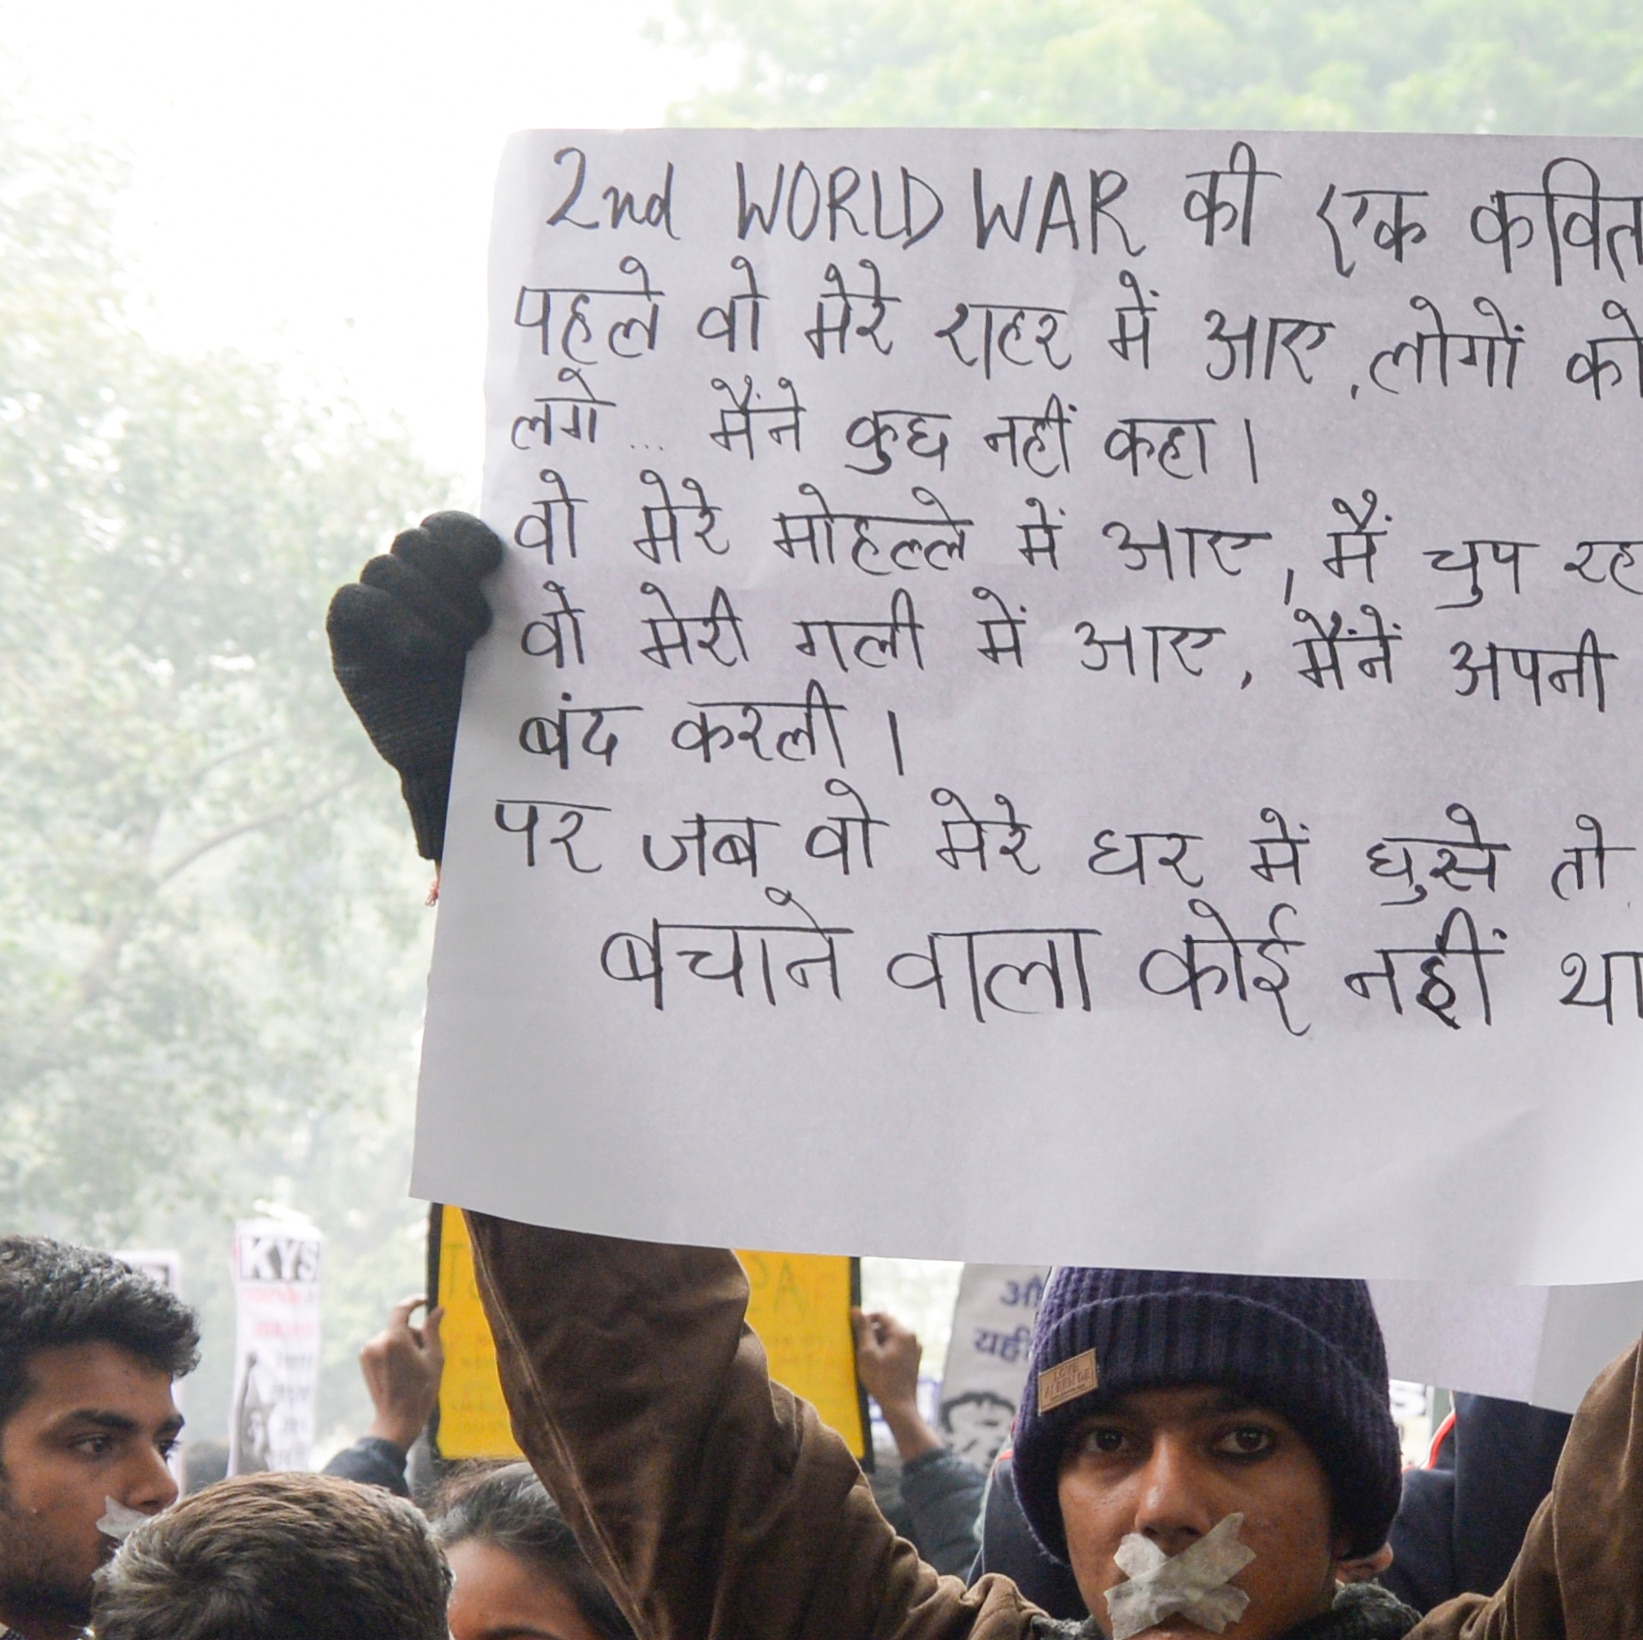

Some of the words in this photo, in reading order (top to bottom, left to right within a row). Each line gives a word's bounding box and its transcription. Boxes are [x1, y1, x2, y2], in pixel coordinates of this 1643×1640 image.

[544, 145, 682, 242] 2nd
[734, 159, 946, 252] WORLD
[971, 166, 1148, 259] WAR
[1182, 139, 1284, 249] की
[1314, 182, 1431, 280] एक
[512, 254, 667, 367] पहले
[695, 254, 771, 354] वो
[802, 257, 904, 362] मेरे
[1106, 268, 1161, 371] में
[1367, 293, 1527, 396] लोगों
[707, 373, 809, 462] मैंने
[981, 391, 1079, 480] नहीं
[513, 467, 590, 567] वो
[631, 467, 731, 566] मेरे
[771, 481, 976, 578] मोहल्ले
[1014, 495, 1067, 572] में
[1320, 487, 1390, 585] मैं
[1420, 538, 1542, 612] चुप
[519, 578, 587, 670] वो
[638, 580, 751, 671] मेरी
[790, 586, 926, 675] गली
[970, 584, 1029, 670] में
[1448, 626, 1621, 715] अपनी
[517, 704, 645, 772] बंद
[493, 798, 614, 875] पर
[641, 811, 783, 880] जब
[803, 776, 892, 877] वो
[929, 786, 1042, 877] मेरे
[1247, 805, 1312, 887] में
[1549, 812, 1638, 902] तो
[599, 885, 856, 1013] बचाने
[885, 926, 1104, 1025] वाला
[1137, 897, 1313, 1038] कोई
[1342, 905, 1509, 1032] नहीं
